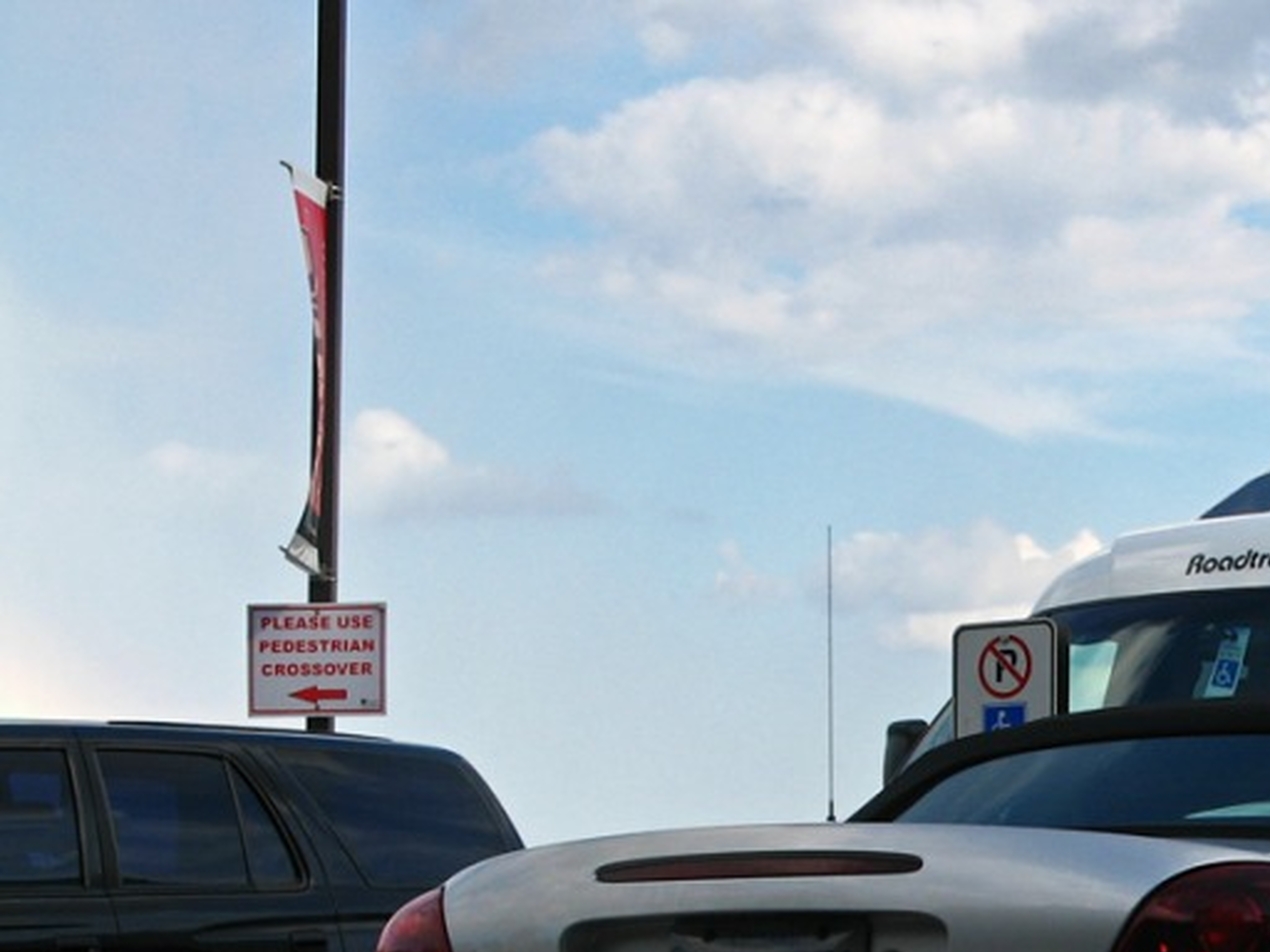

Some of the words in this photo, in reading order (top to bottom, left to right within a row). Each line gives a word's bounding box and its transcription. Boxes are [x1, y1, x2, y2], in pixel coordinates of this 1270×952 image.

[261, 616, 330, 630] PLEASE
[337, 614, 374, 629] USE
[259, 639, 375, 653] PEDESTRIAN
[261, 661, 373, 677] CROSSOVER
